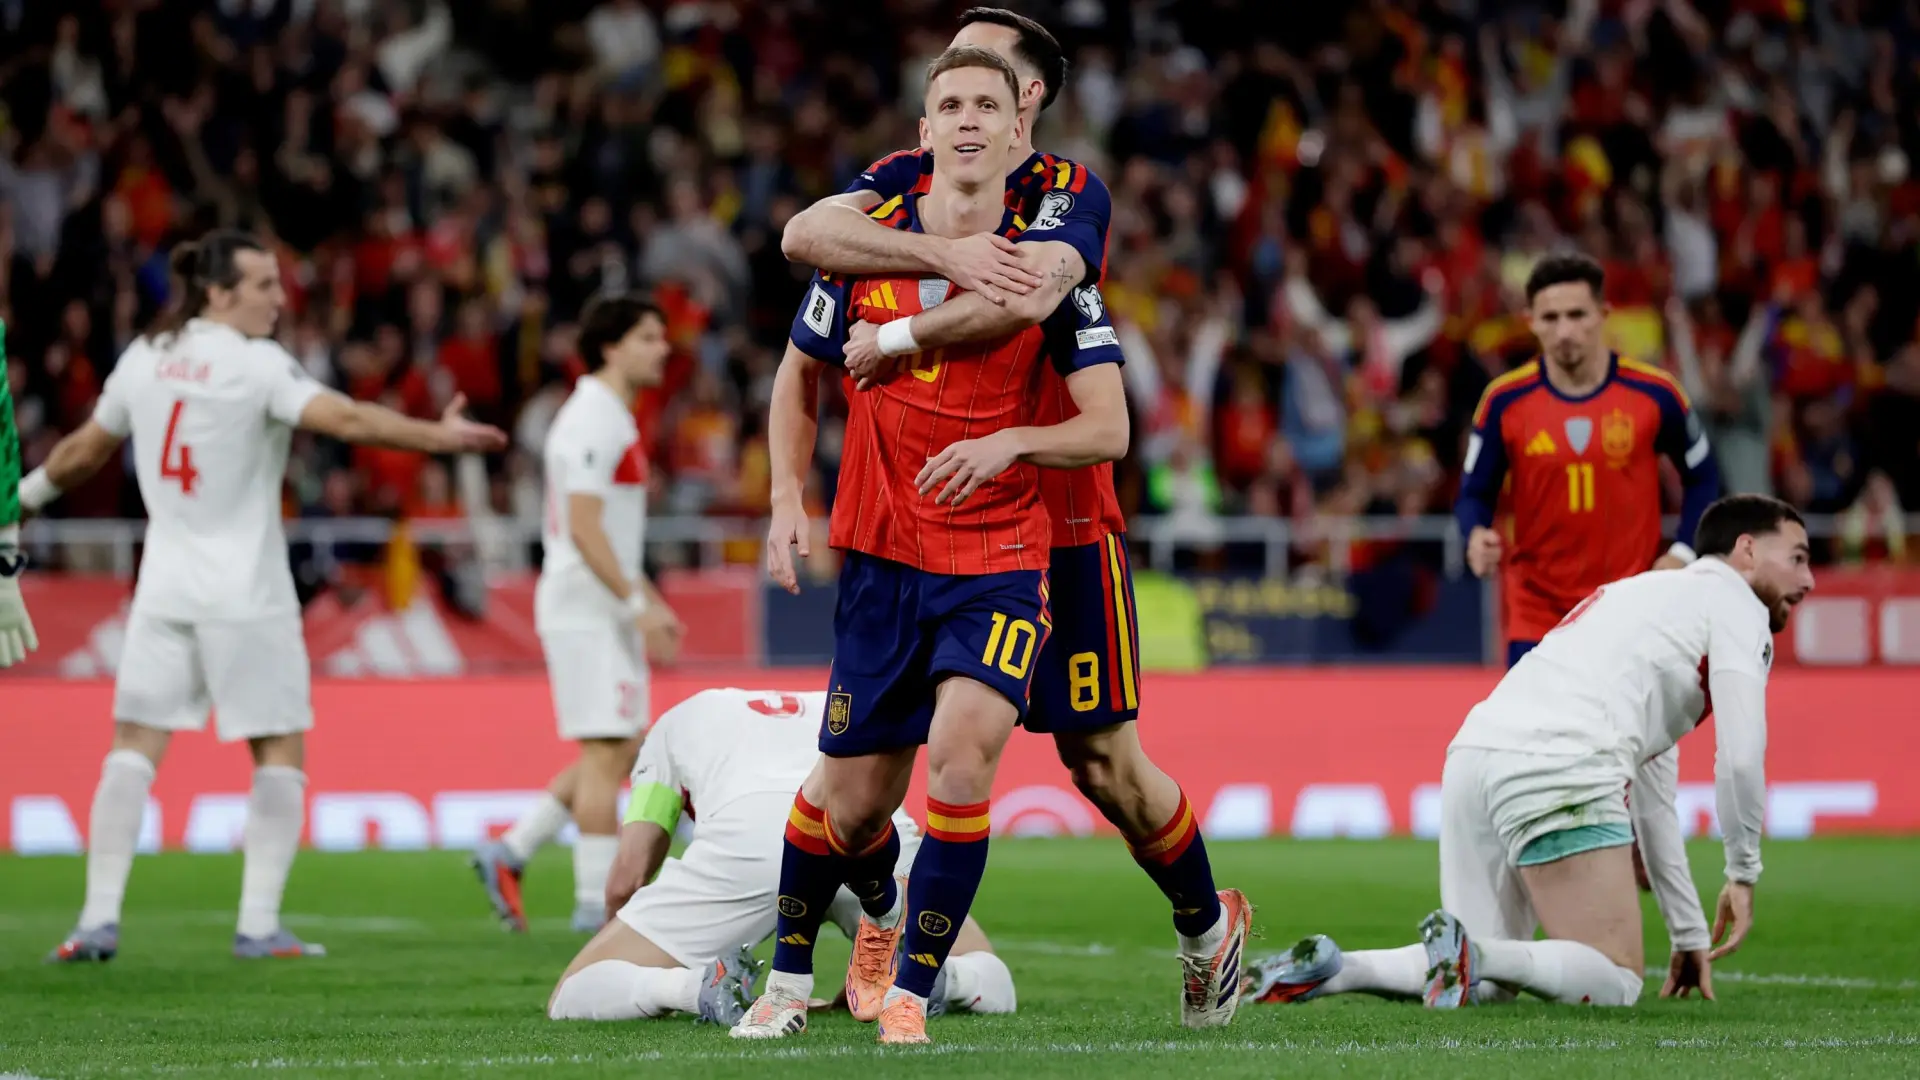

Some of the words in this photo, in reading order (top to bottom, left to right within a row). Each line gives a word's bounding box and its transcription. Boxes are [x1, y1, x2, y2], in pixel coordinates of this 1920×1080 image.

[160, 400, 198, 496] 4
[1565, 463, 1595, 513] 11
[982, 612, 1037, 680] 10
[1069, 652, 1099, 712] 8
